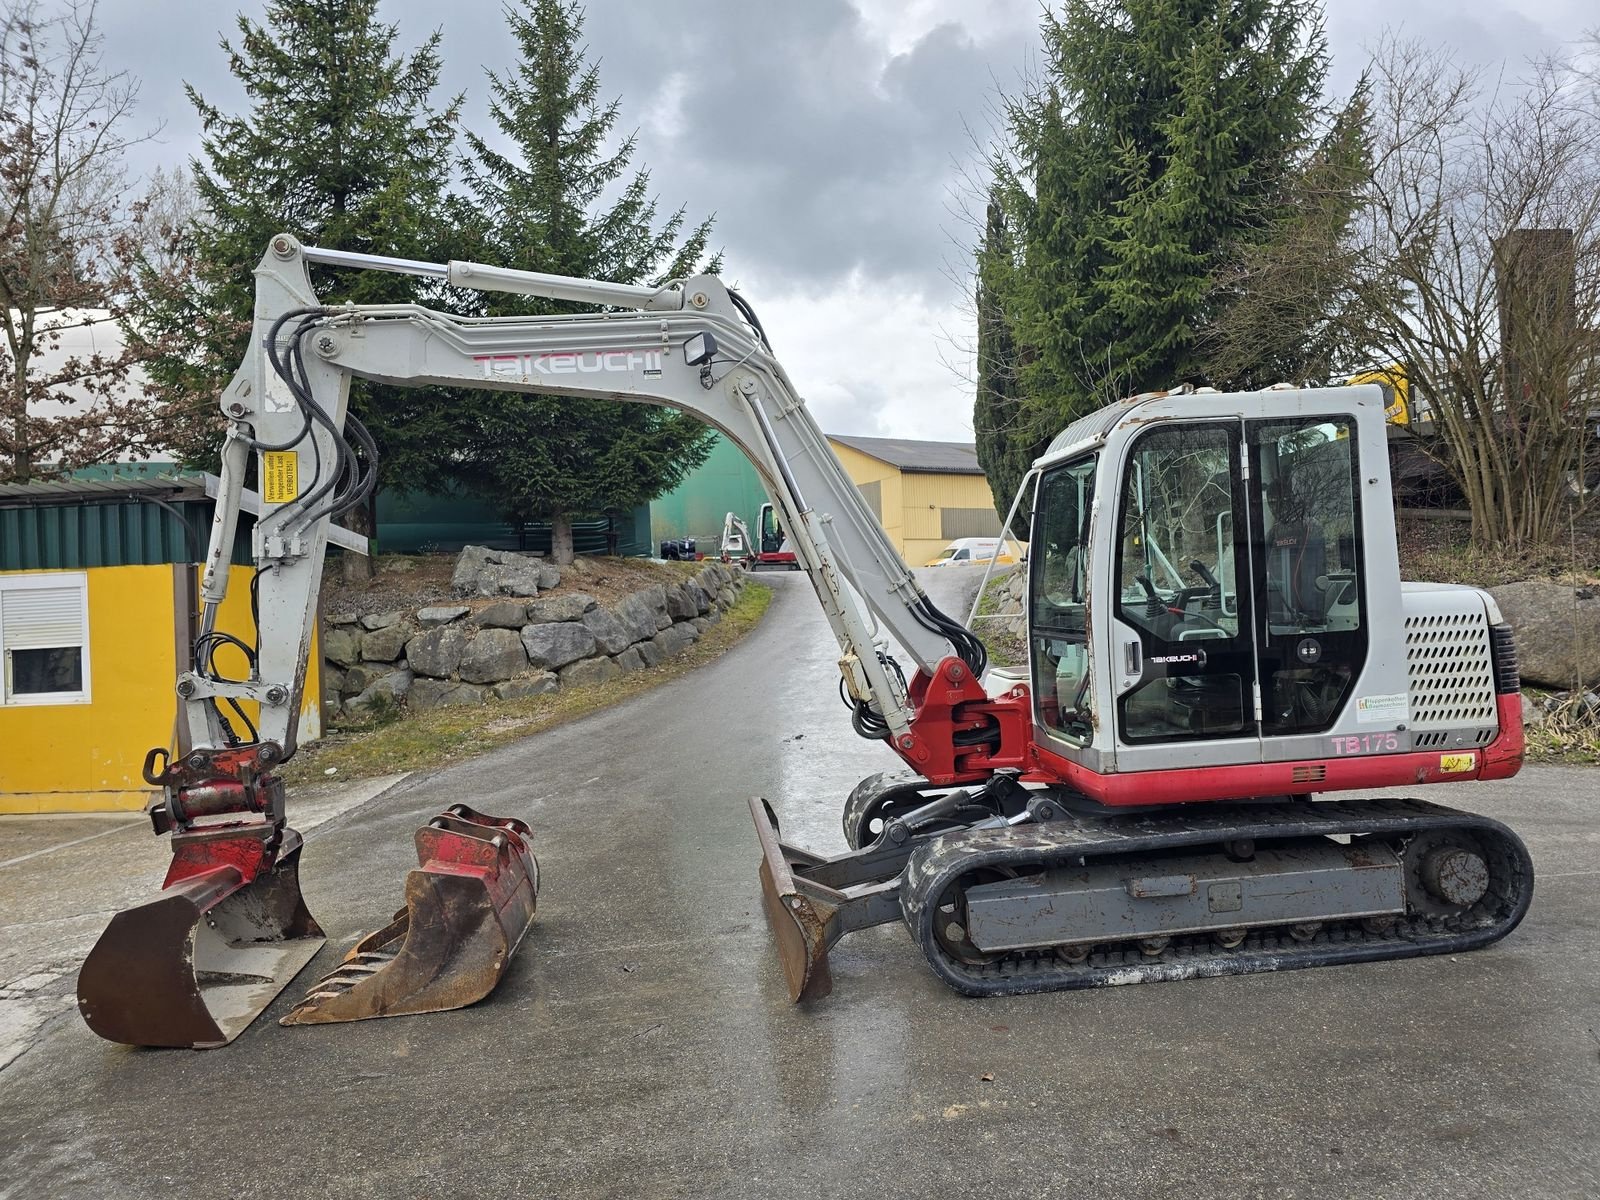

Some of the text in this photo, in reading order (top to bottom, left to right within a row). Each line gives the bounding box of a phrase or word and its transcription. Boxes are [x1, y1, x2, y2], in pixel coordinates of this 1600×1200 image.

[473, 350, 662, 376] TAKEUCHI
[1151, 655, 1197, 663] TAKEUCHI
[1331, 733, 1398, 754] TB175
